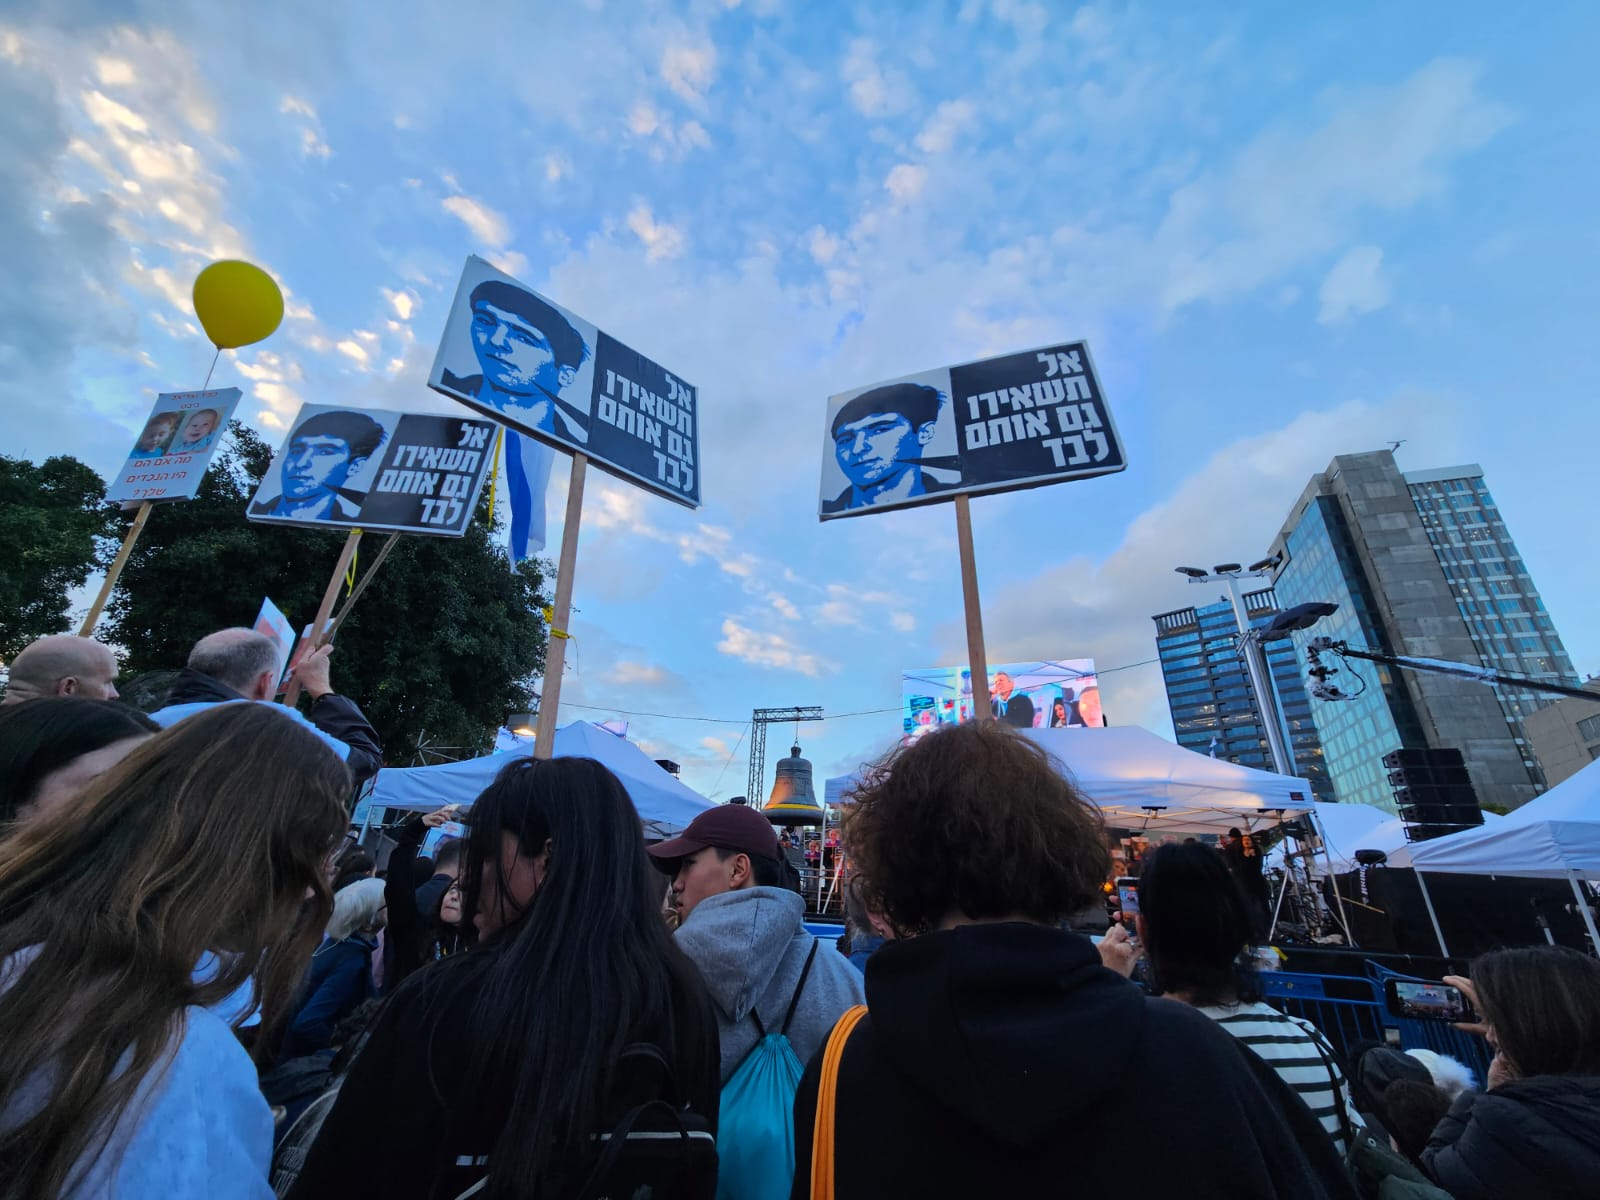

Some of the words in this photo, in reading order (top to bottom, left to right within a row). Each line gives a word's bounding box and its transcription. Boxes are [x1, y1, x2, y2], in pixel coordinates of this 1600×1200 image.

[1036, 350, 1084, 377] אל
[606, 368, 692, 439] תשאירו
[665, 372, 692, 412] אל
[967, 374, 1092, 420] תשאירו
[598, 393, 662, 449] אותם
[964, 409, 1051, 451] אותם
[1056, 401, 1103, 433] גם
[458, 422, 490, 449] אל
[667, 428, 694, 466] גם
[1041, 429, 1110, 468] לבד
[134, 460, 151, 468] הם
[153, 457, 172, 466] אם
[174, 456, 192, 464] מה
[392, 444, 481, 473] תשאירו
[653, 450, 694, 492] לבד
[125, 472, 169, 483] הנכדים
[171, 471, 187, 479] היו
[376, 469, 440, 495] אותם
[439, 473, 472, 499] גם
[420, 497, 464, 525] לבד
